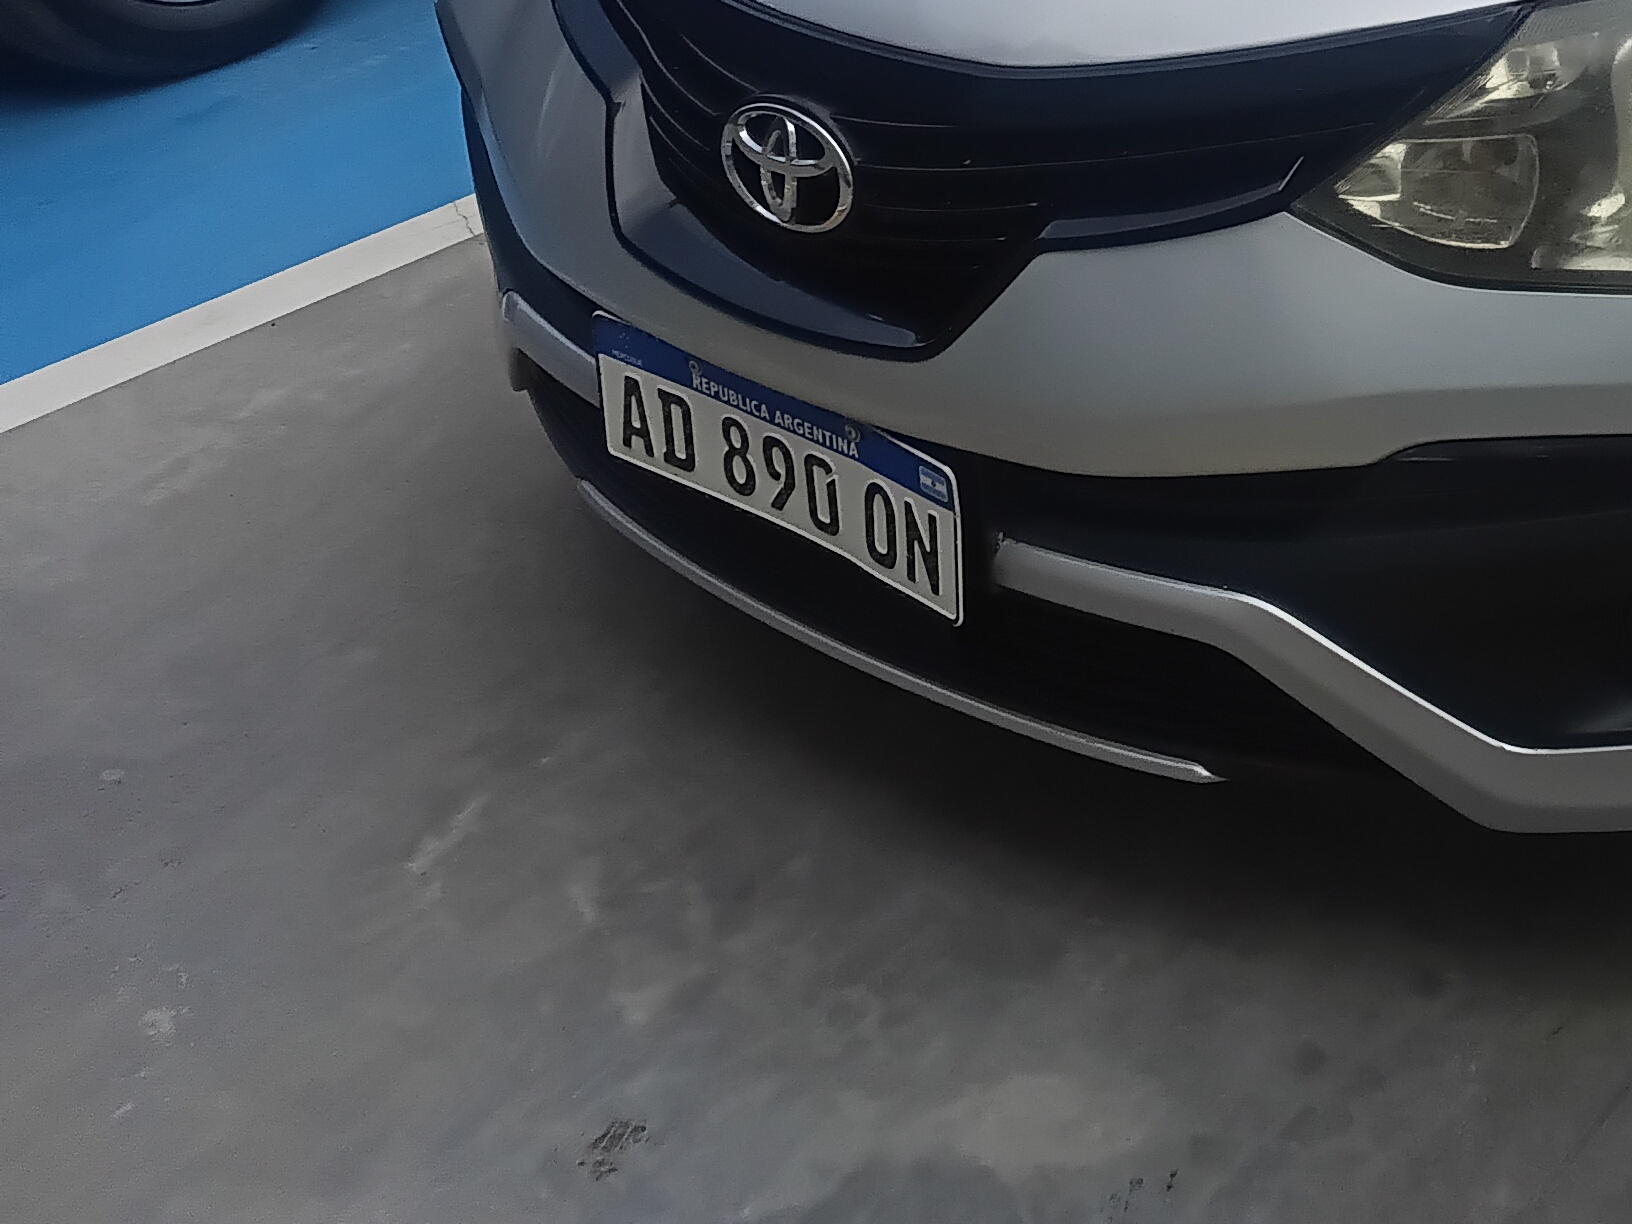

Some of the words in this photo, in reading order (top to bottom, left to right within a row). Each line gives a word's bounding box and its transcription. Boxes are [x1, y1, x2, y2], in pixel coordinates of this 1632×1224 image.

[622, 375, 696, 473] AD
[721, 416, 840, 536] 890
[864, 479, 941, 596] ON
[692, 374, 770, 421] REPUBLICA
[774, 410, 859, 459] ARGENTINA
